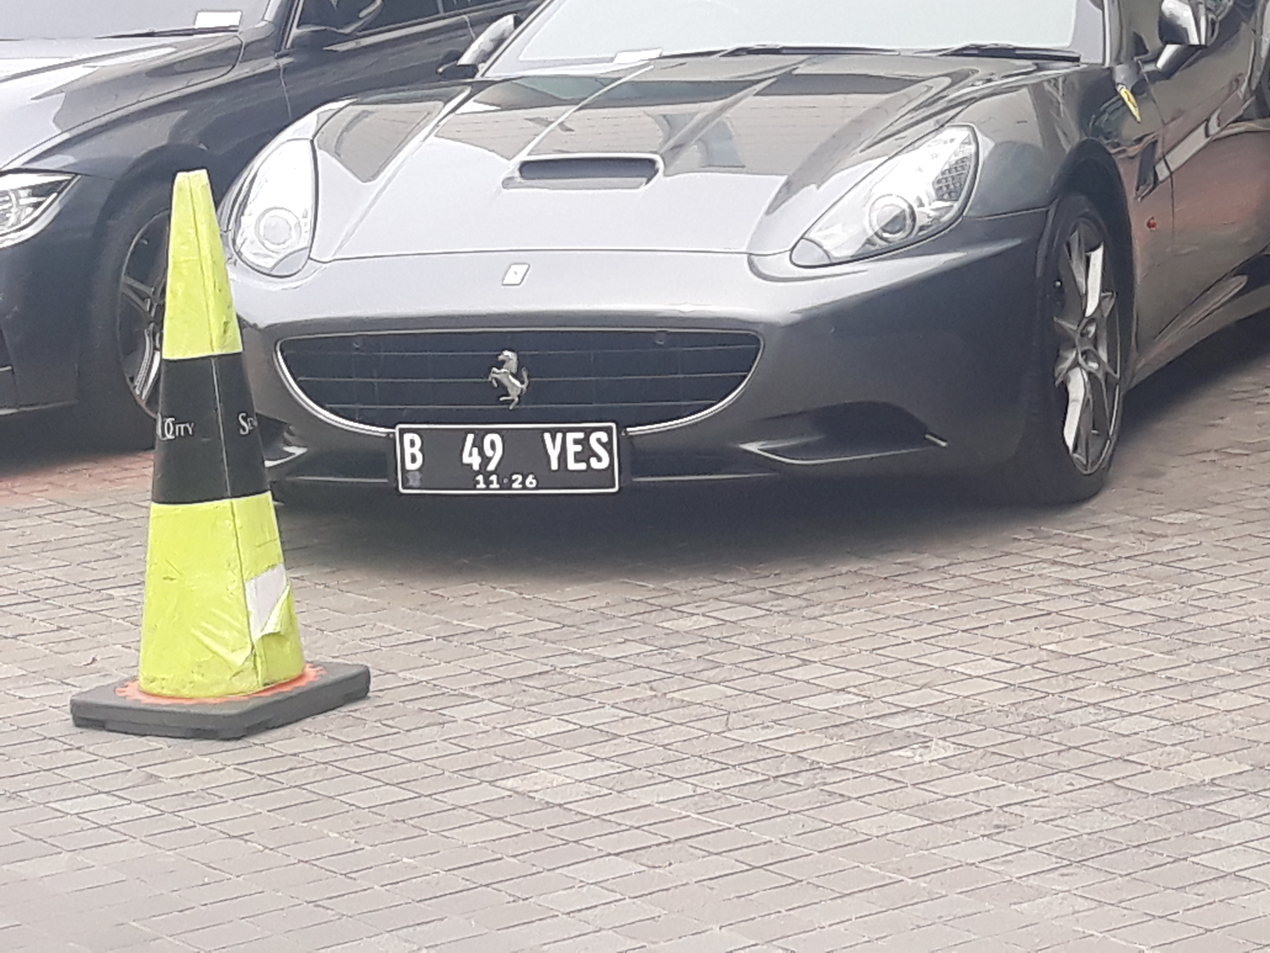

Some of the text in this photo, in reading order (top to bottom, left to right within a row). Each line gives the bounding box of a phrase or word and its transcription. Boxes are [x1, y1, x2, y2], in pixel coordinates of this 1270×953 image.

[403, 431, 610, 471] B 49 YES
